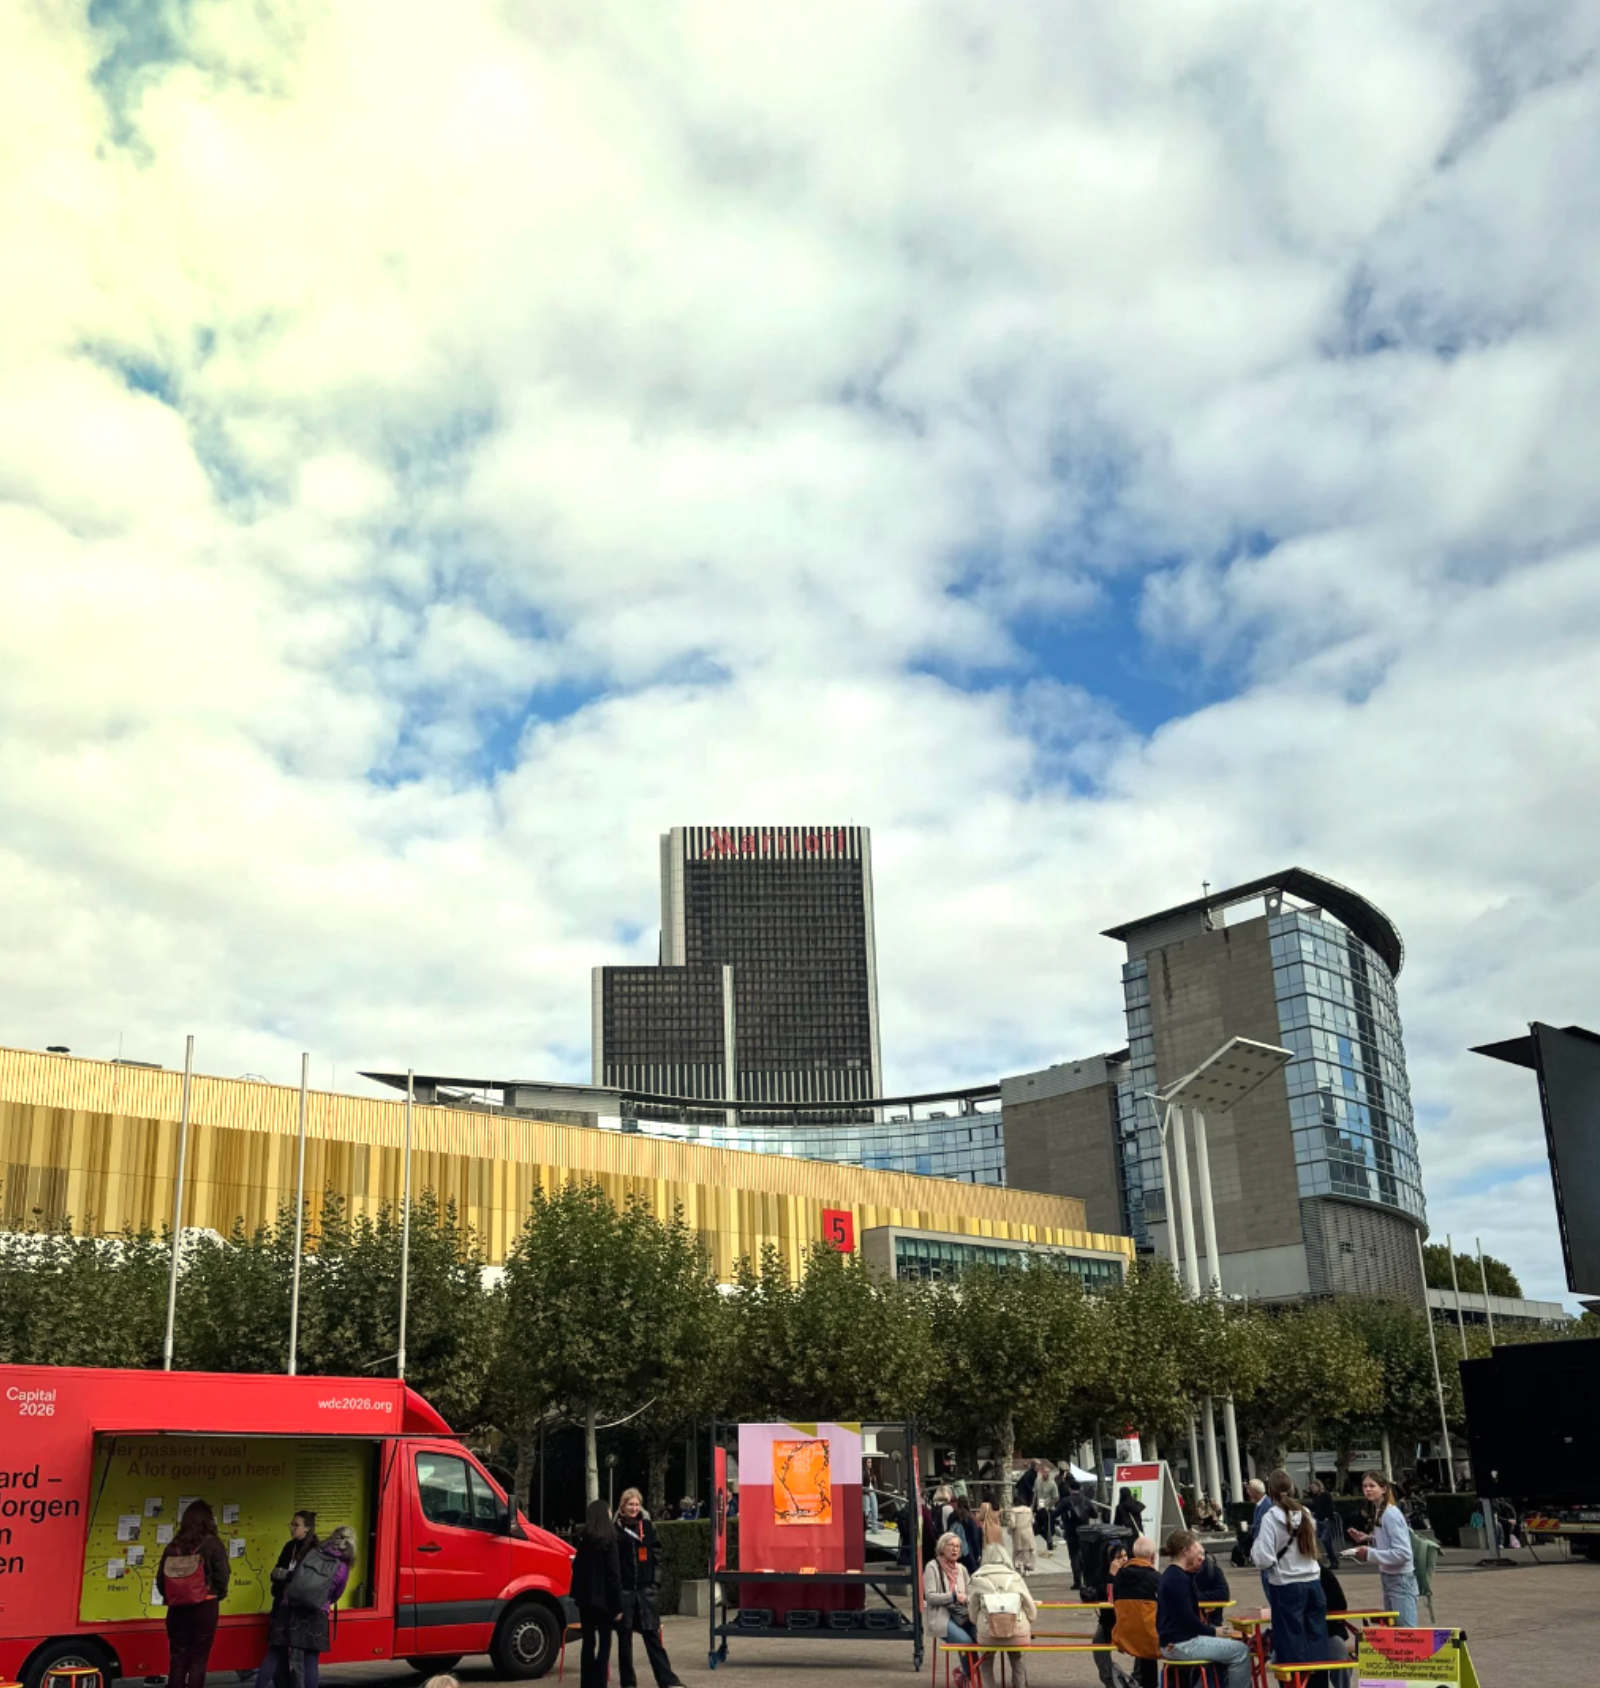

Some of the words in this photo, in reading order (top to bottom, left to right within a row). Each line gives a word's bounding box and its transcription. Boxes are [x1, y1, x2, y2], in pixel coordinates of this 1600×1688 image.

[702, 829, 845, 857] Marriott
[832, 1217, 846, 1244] 5
[6, 1386, 57, 1404] Capital
[19, 1402, 55, 1417] 2026
[317, 1397, 392, 1413] wdc2026.org
[139, 1442, 205, 1460] passiert
[211, 1442, 246, 1458] was!
[127, 1461, 140, 1476] A
[146, 1460, 166, 1476] lot
[172, 1463, 217, 1479] going
[222, 1463, 242, 1476] on
[247, 1461, 286, 1477] here!
[0, 1492, 80, 1524] orgen
